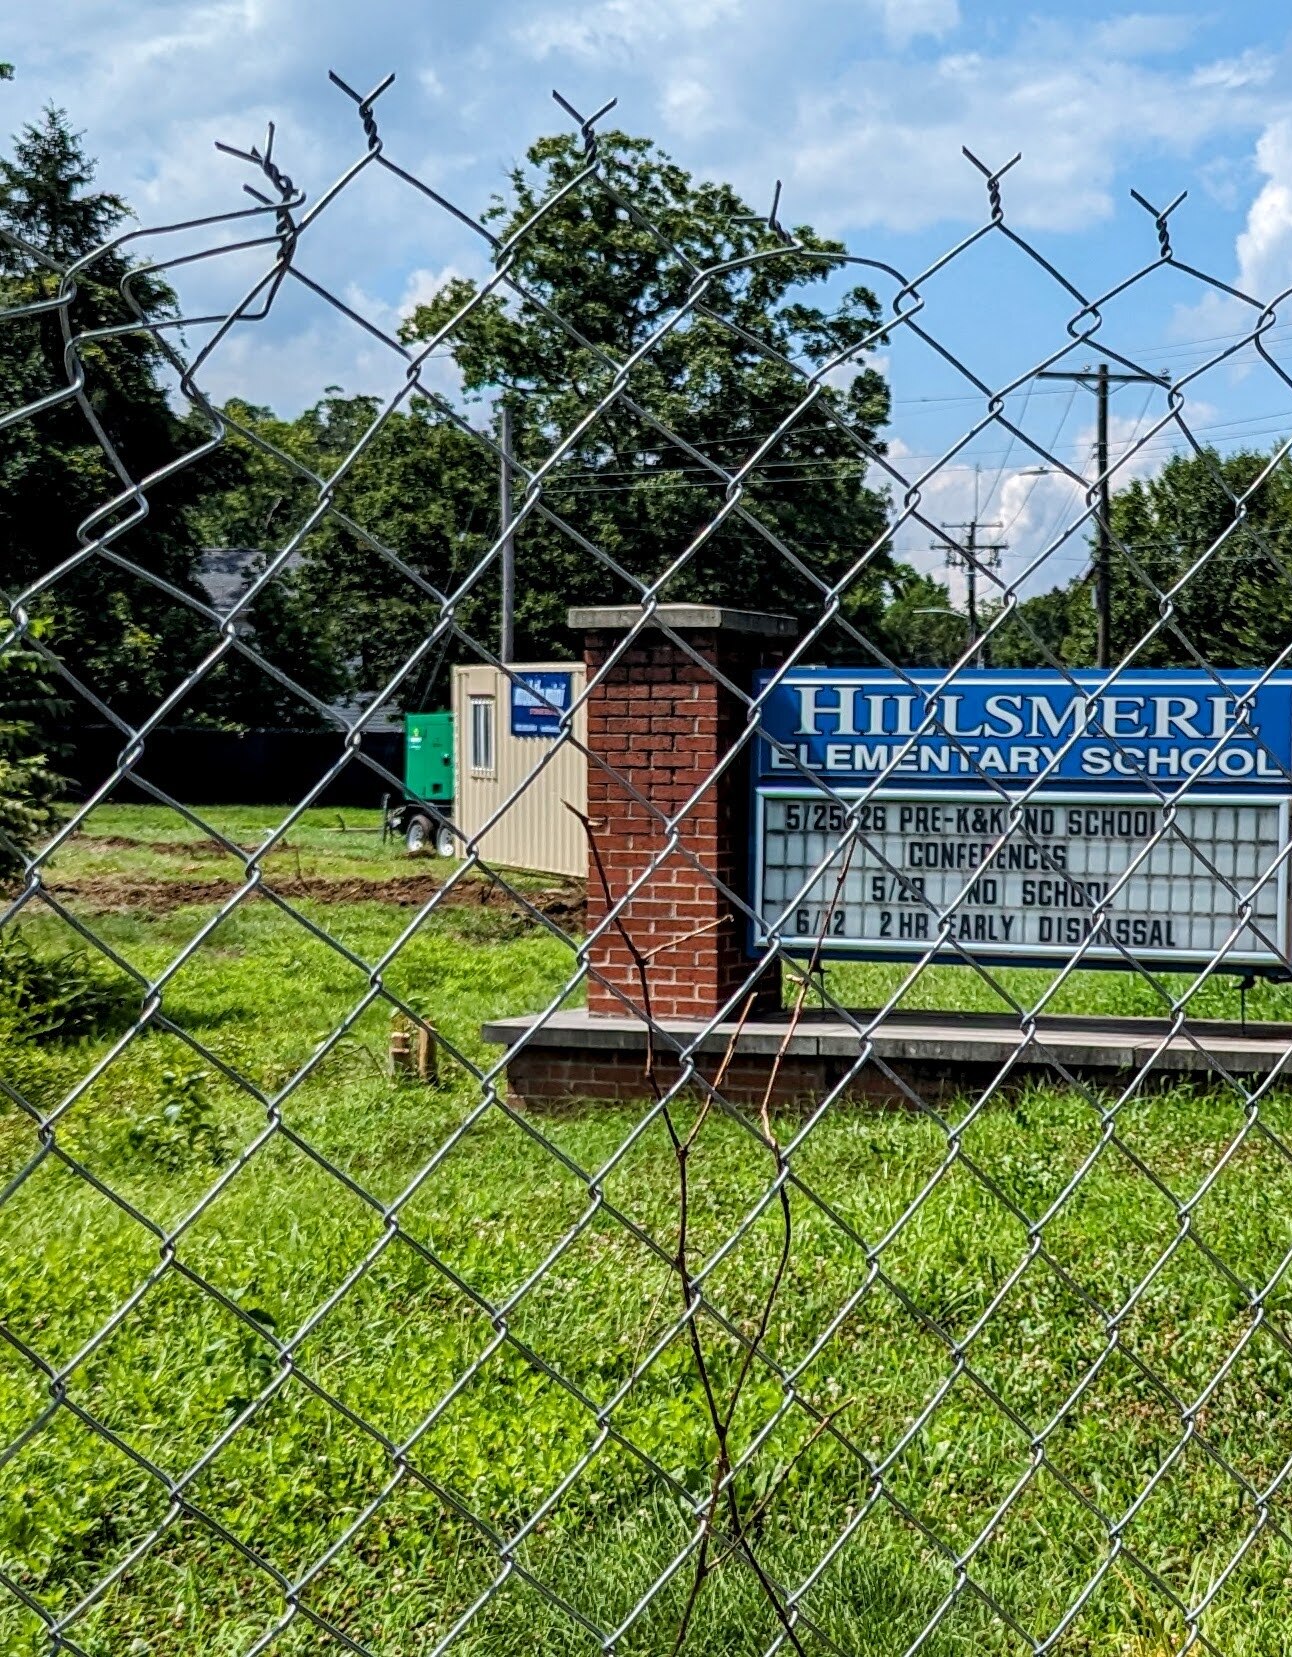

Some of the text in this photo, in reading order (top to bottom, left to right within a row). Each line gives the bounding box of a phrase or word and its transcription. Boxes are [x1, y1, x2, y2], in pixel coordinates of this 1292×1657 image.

[793, 686, 1260, 739] HILLSMERE
[771, 744, 1283, 777] ELEMENTARY SCHOOL
[786, 805, 1160, 837] 5/2526 PRE-K&K NO SCHOOL
[910, 842, 1067, 871] CONFERENCES
[872, 876, 1113, 909] 5/29 NO SCHOOL
[796, 909, 1176, 947] 6/12 2 HR EARLY DISMISSAL
